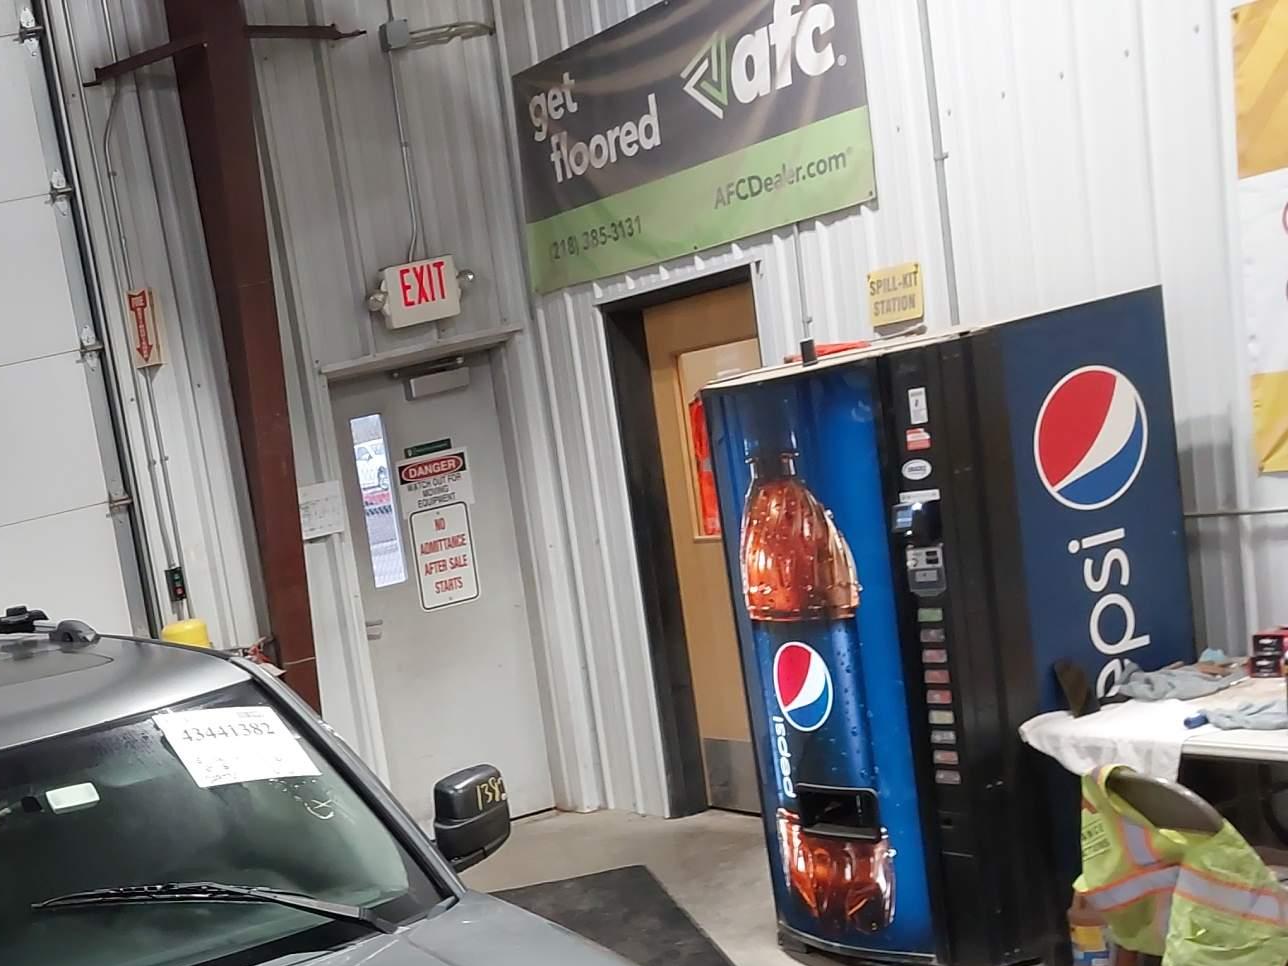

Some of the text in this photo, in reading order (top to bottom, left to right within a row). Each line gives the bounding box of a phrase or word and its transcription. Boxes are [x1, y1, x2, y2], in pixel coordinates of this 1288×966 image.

[730, 0, 836, 104] afc
[528, 71, 579, 142] get
[550, 92, 662, 184] floored
[714, 152, 847, 210] AFCDealer.com
[549, 214, 643, 263] (218) 385-3131
[399, 261, 446, 307] EXIT
[869, 271, 918, 297] SPILL-KIT
[873, 294, 916, 316] STATION
[408, 458, 457, 478] DANGER
[432, 477, 446, 487] OUT
[448, 472, 462, 483] FOR
[417, 491, 456, 509] EQUIPMENT
[420, 533, 466, 556] ADMITTANCE
[424, 553, 468, 576] AFTER SALE
[434, 576, 464, 594] STARTS
[1068, 527, 1151, 699] epsi
[183, 722, 276, 742] 43441382
[772, 715, 797, 798] pepsi
